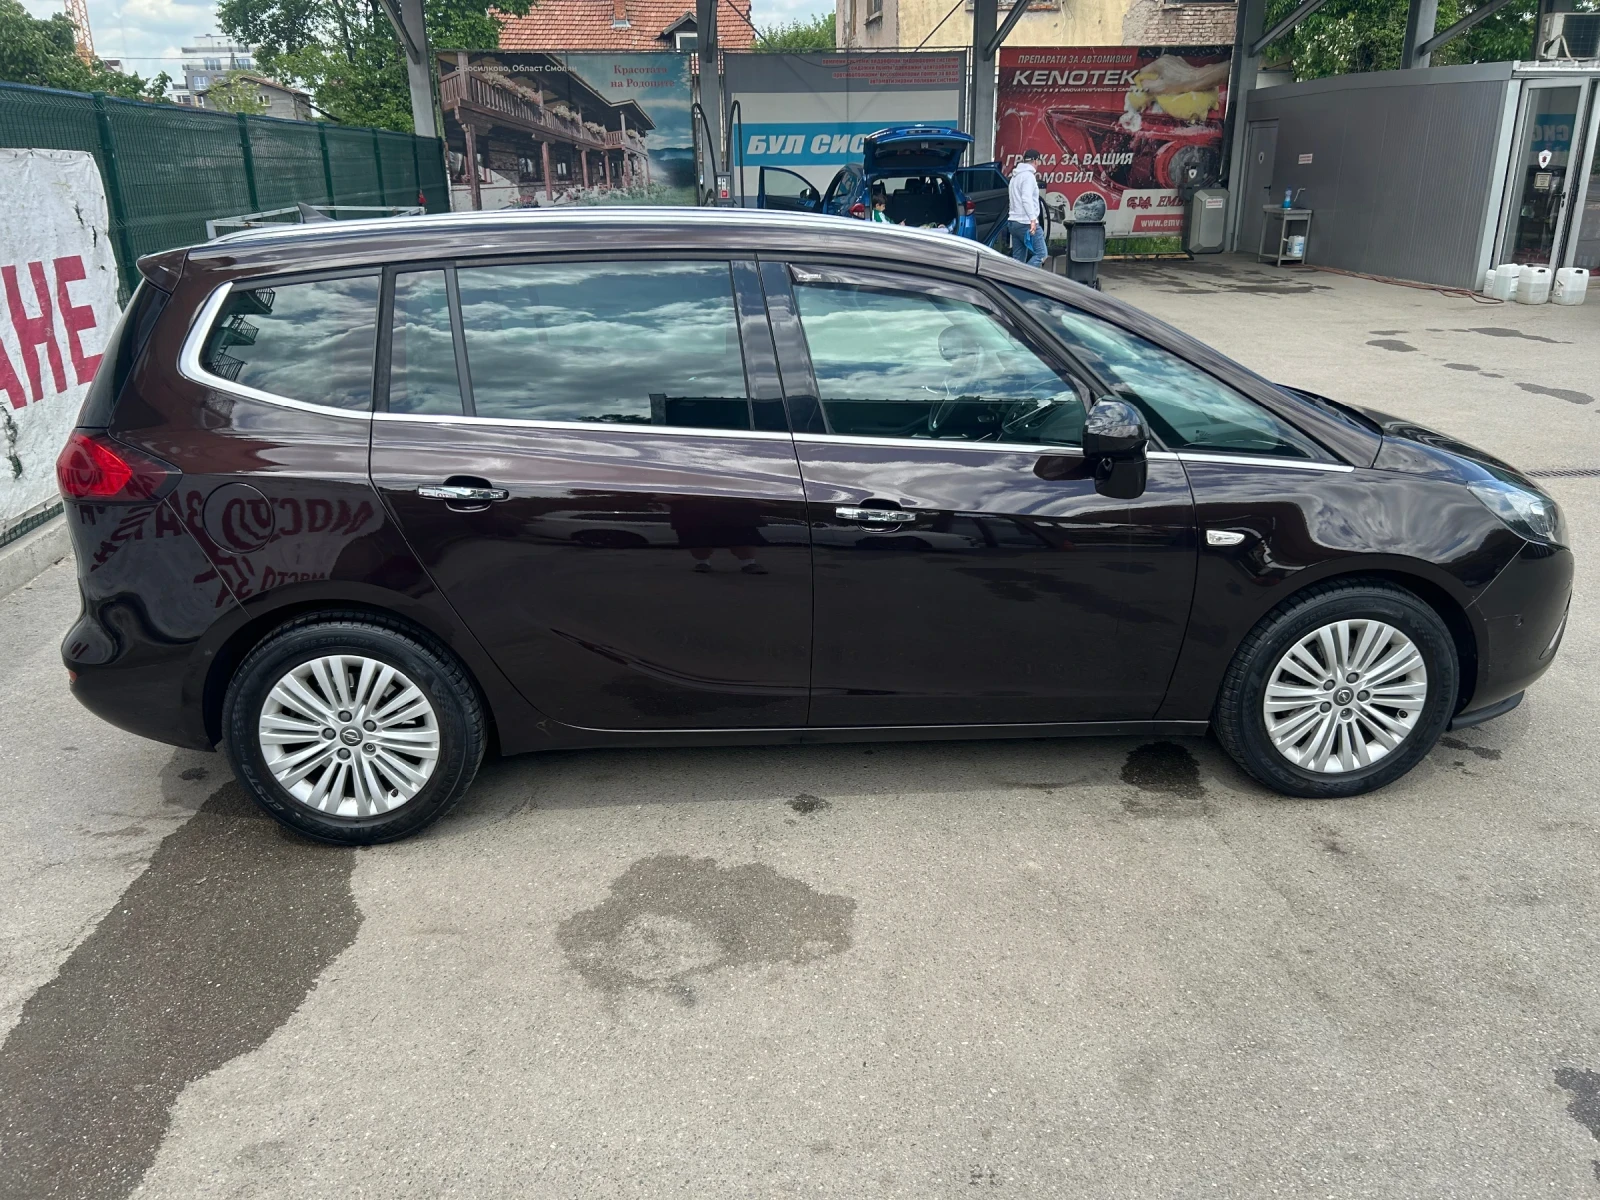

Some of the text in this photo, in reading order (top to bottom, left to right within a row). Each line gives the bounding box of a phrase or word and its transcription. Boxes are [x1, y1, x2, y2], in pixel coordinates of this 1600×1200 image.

[1018, 55, 1132, 64] ПРЕПАРАТИ ЗА АВТОМИВКИ
[512, 64, 543, 72] Област
[614, 65, 668, 75] Красотата
[1012, 70, 1139, 85] KENOTEK
[627, 79, 675, 88] Родопите
[747, 135, 805, 155] БУЛ
[1060, 153, 1080, 165] ЗА
[1082, 152, 1133, 165] ВАШИЯ
